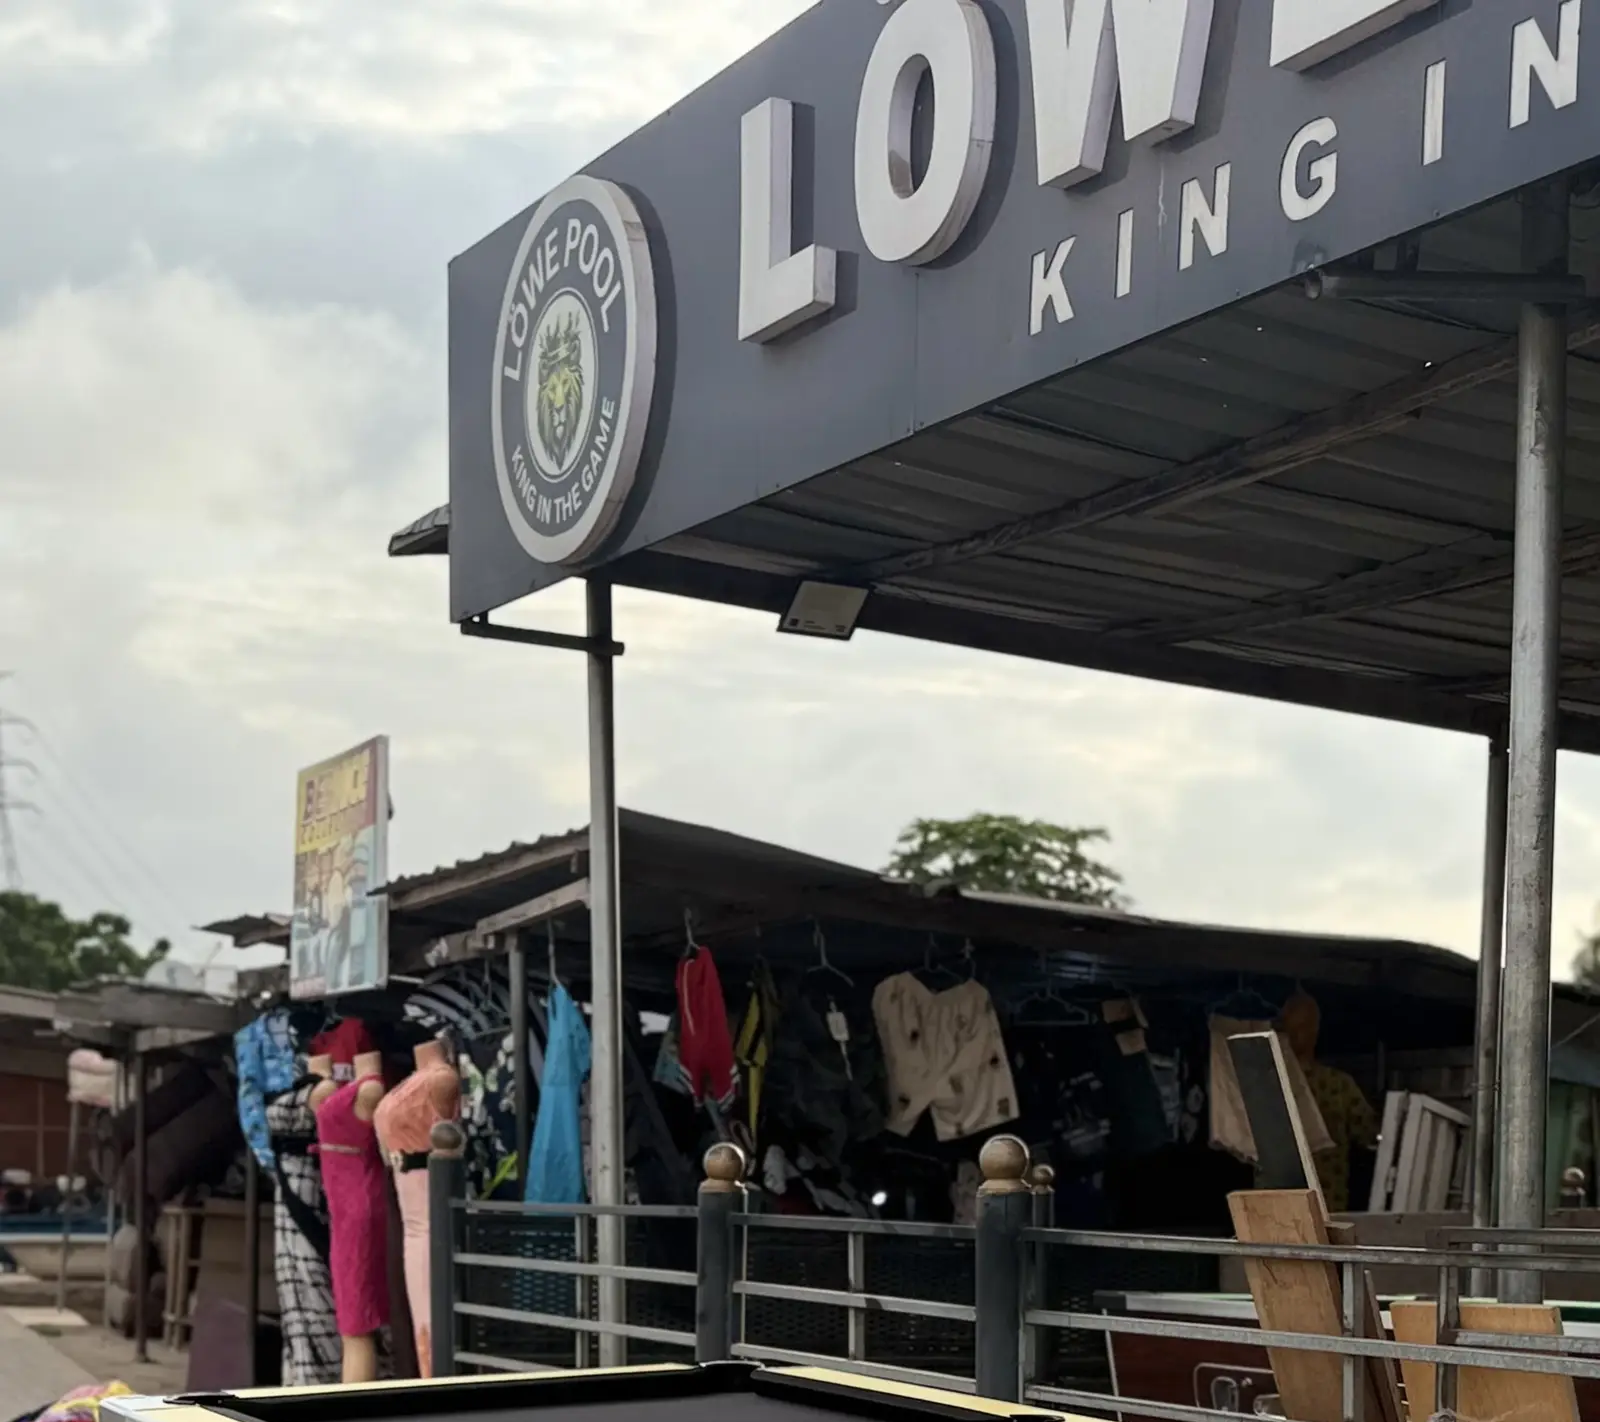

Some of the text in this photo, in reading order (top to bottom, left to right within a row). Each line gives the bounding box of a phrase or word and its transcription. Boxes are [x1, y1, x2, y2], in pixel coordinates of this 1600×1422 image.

[1029, 0, 1582, 337] KING IN
[504, 217, 622, 382] LÖWE POOL
[510, 395, 616, 526] KING IN THE GAME
